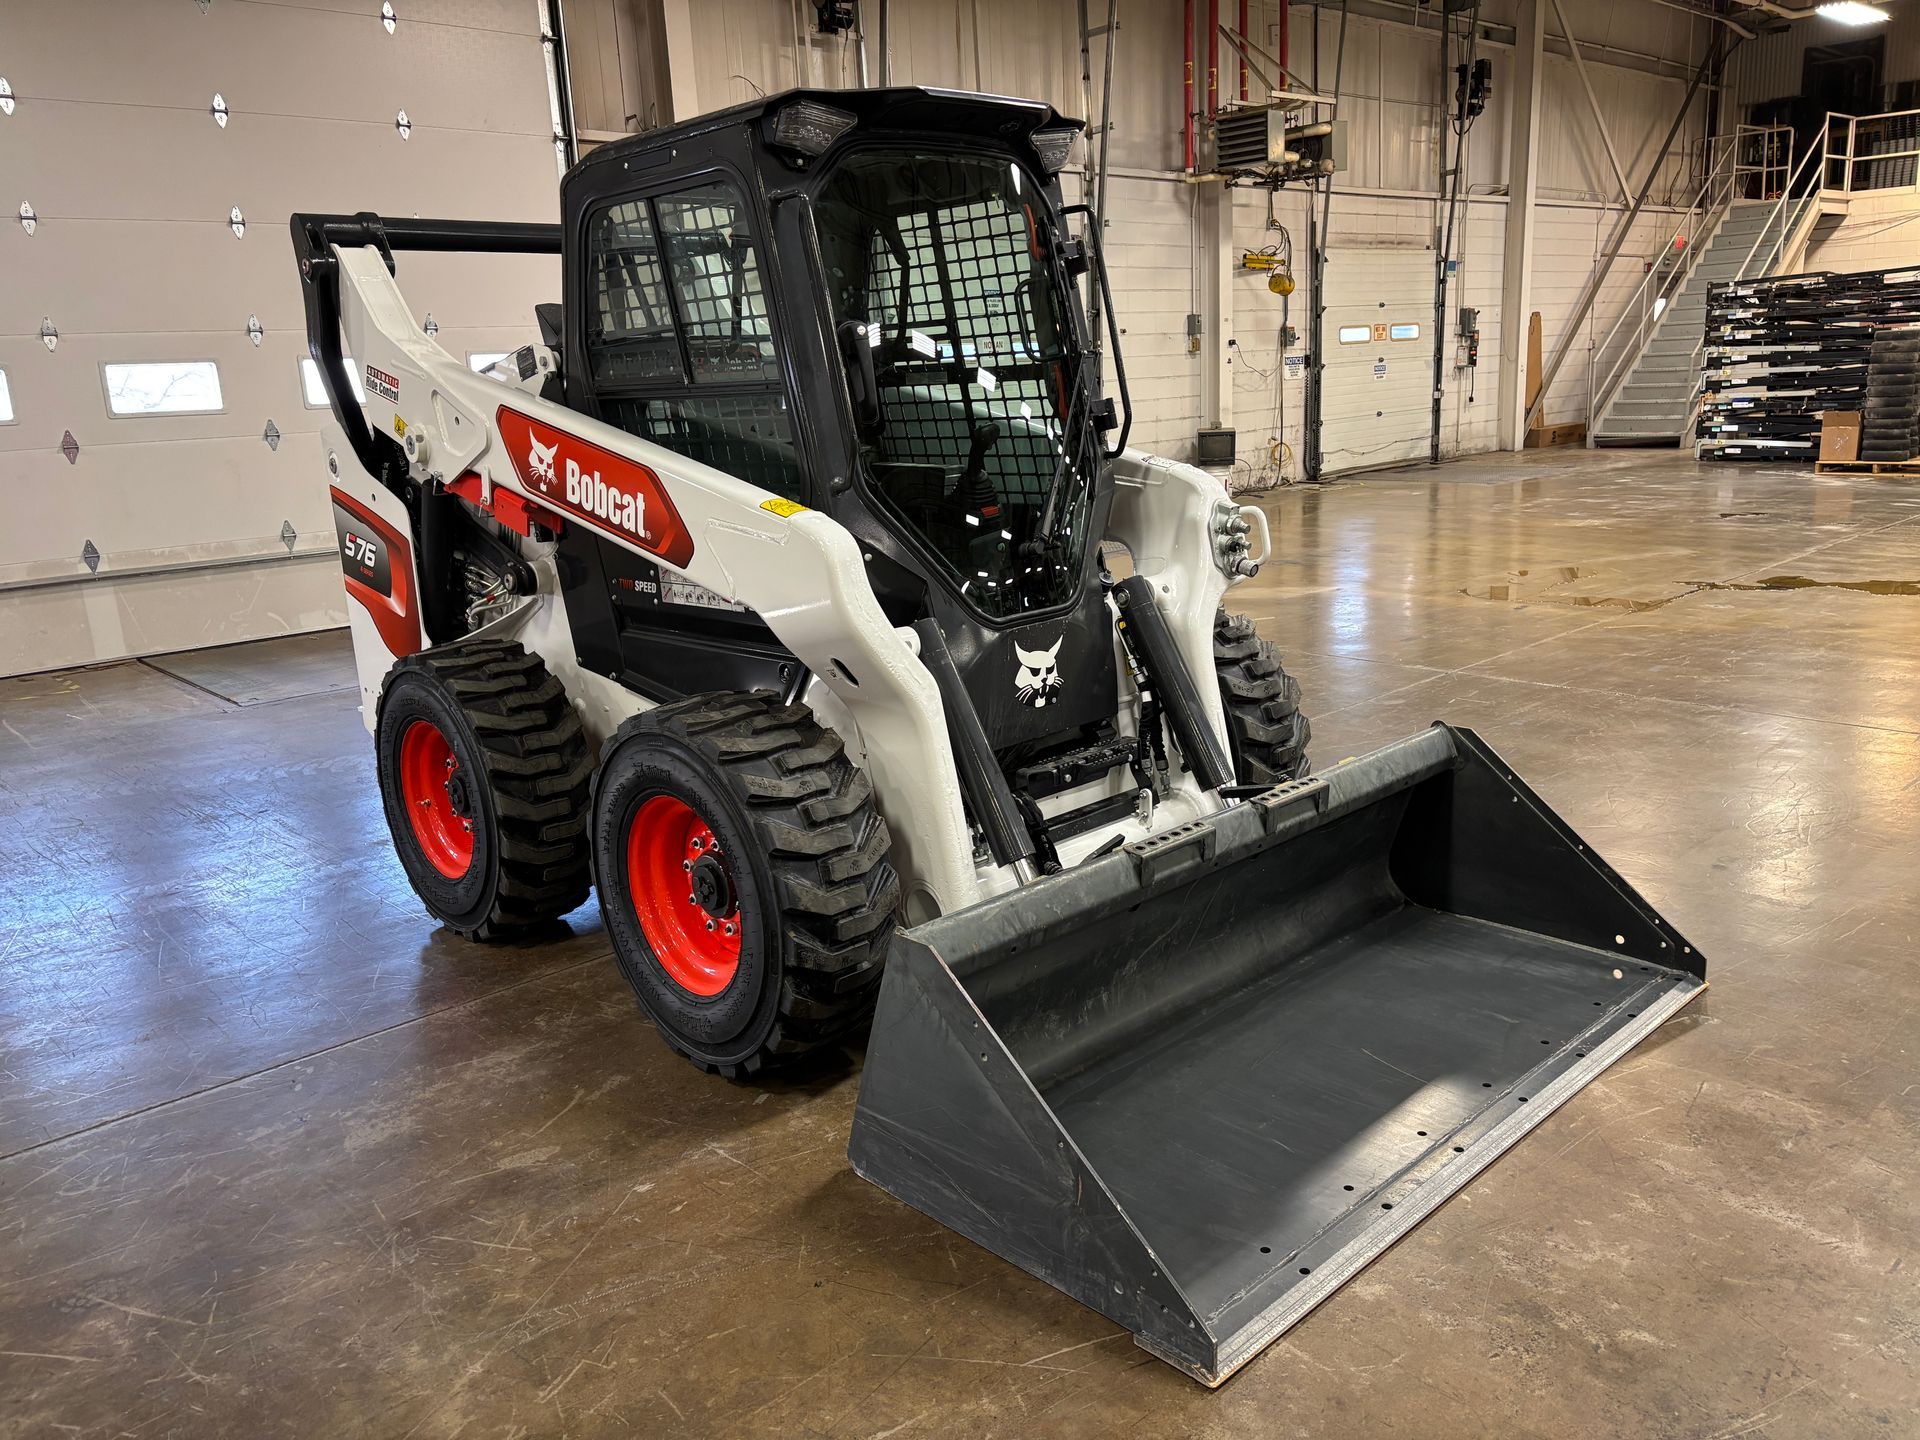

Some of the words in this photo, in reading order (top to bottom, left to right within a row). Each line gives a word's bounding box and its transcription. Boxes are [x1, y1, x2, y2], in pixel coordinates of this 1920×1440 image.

[1285, 357, 1303, 365] NOTICE
[366, 376, 379, 391] Ride
[378, 382, 399, 402] Control
[367, 367, 399, 388] AUTOMATIC
[566, 457, 646, 539] Bobcat
[345, 532, 377, 568] S76
[619, 578, 634, 590] TWO
[634, 580, 656, 593] SPEED
